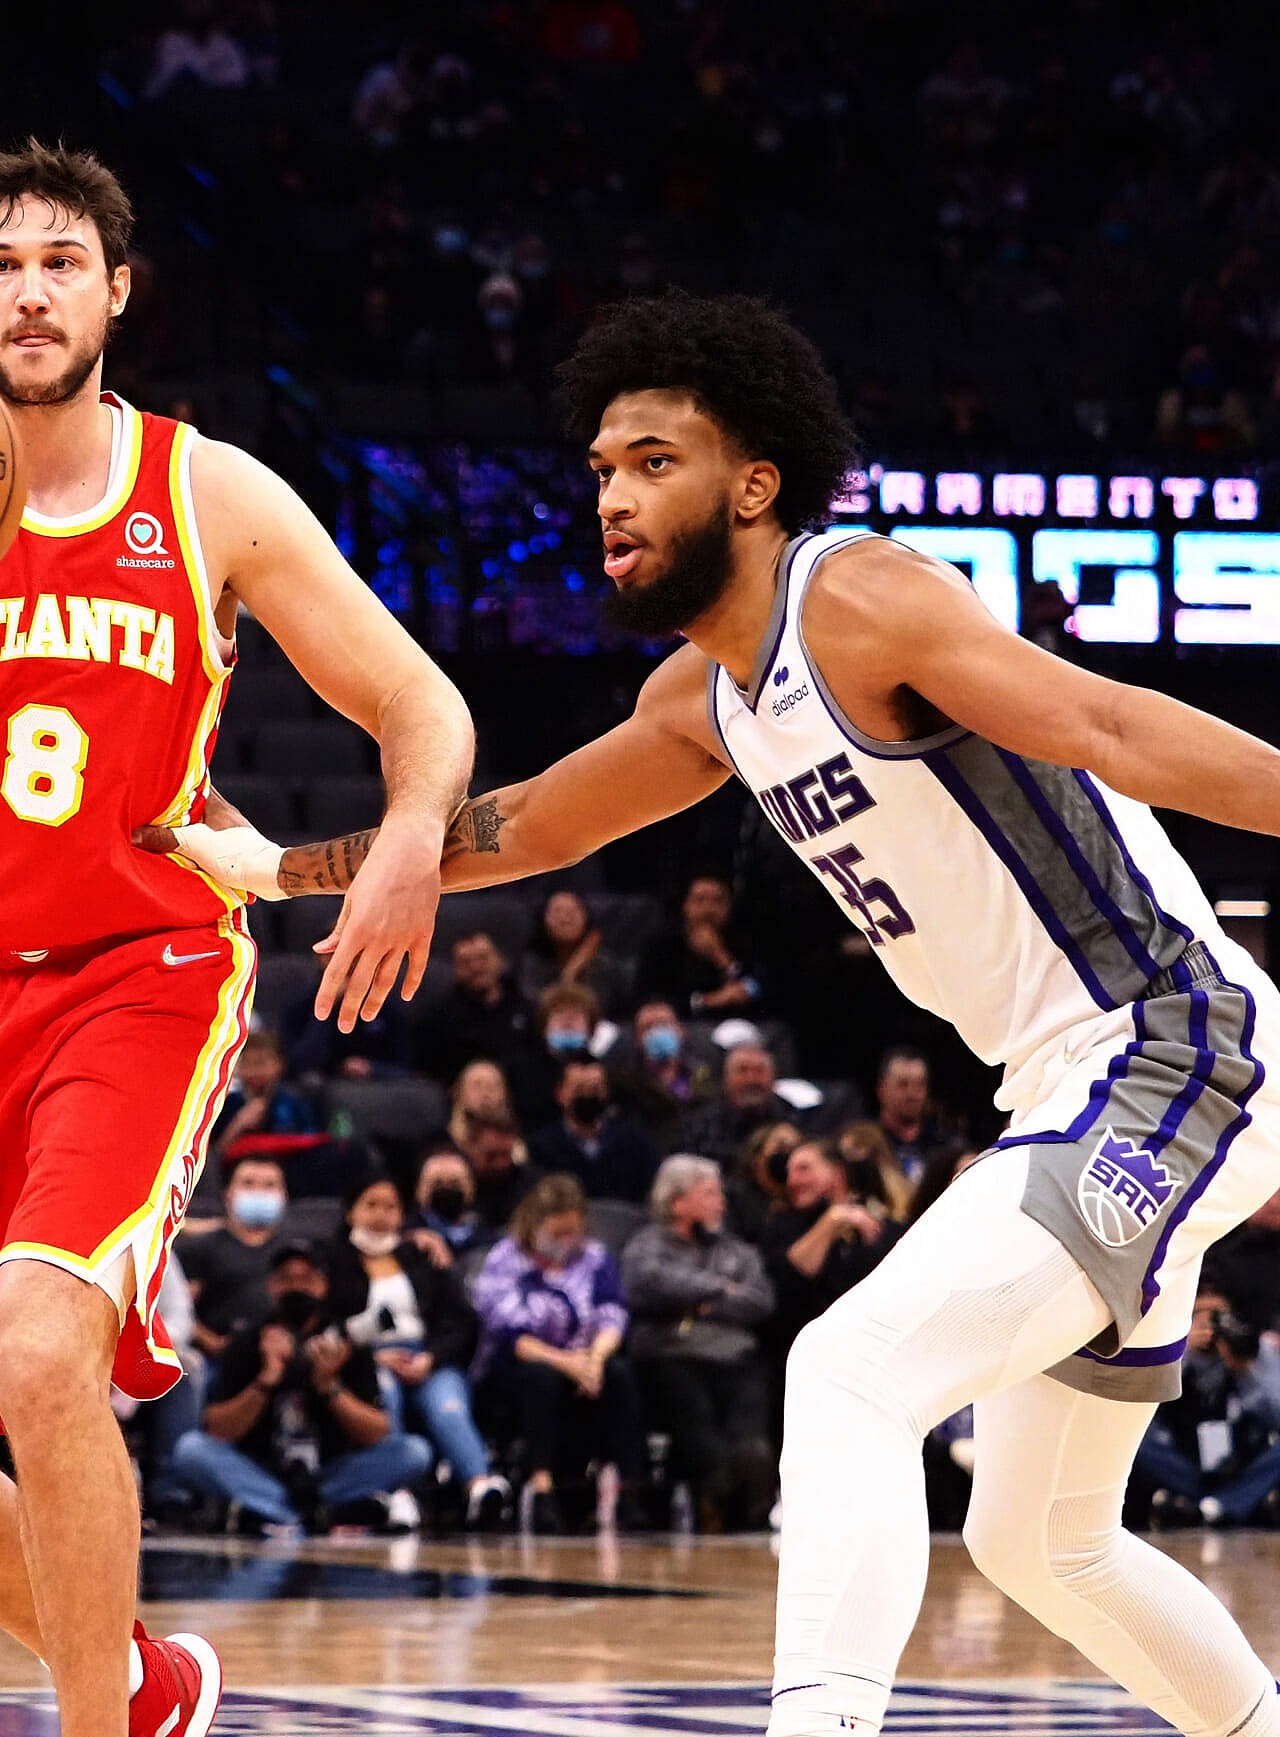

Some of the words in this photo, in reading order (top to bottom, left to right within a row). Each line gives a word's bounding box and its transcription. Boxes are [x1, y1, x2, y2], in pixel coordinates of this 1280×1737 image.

[115, 555, 175, 569] sharecare
[772, 681, 810, 717] dialpad
[0, 702, 90, 828] 8
[809, 842, 917, 947] 35
[1087, 1157, 1158, 1226] SAC
